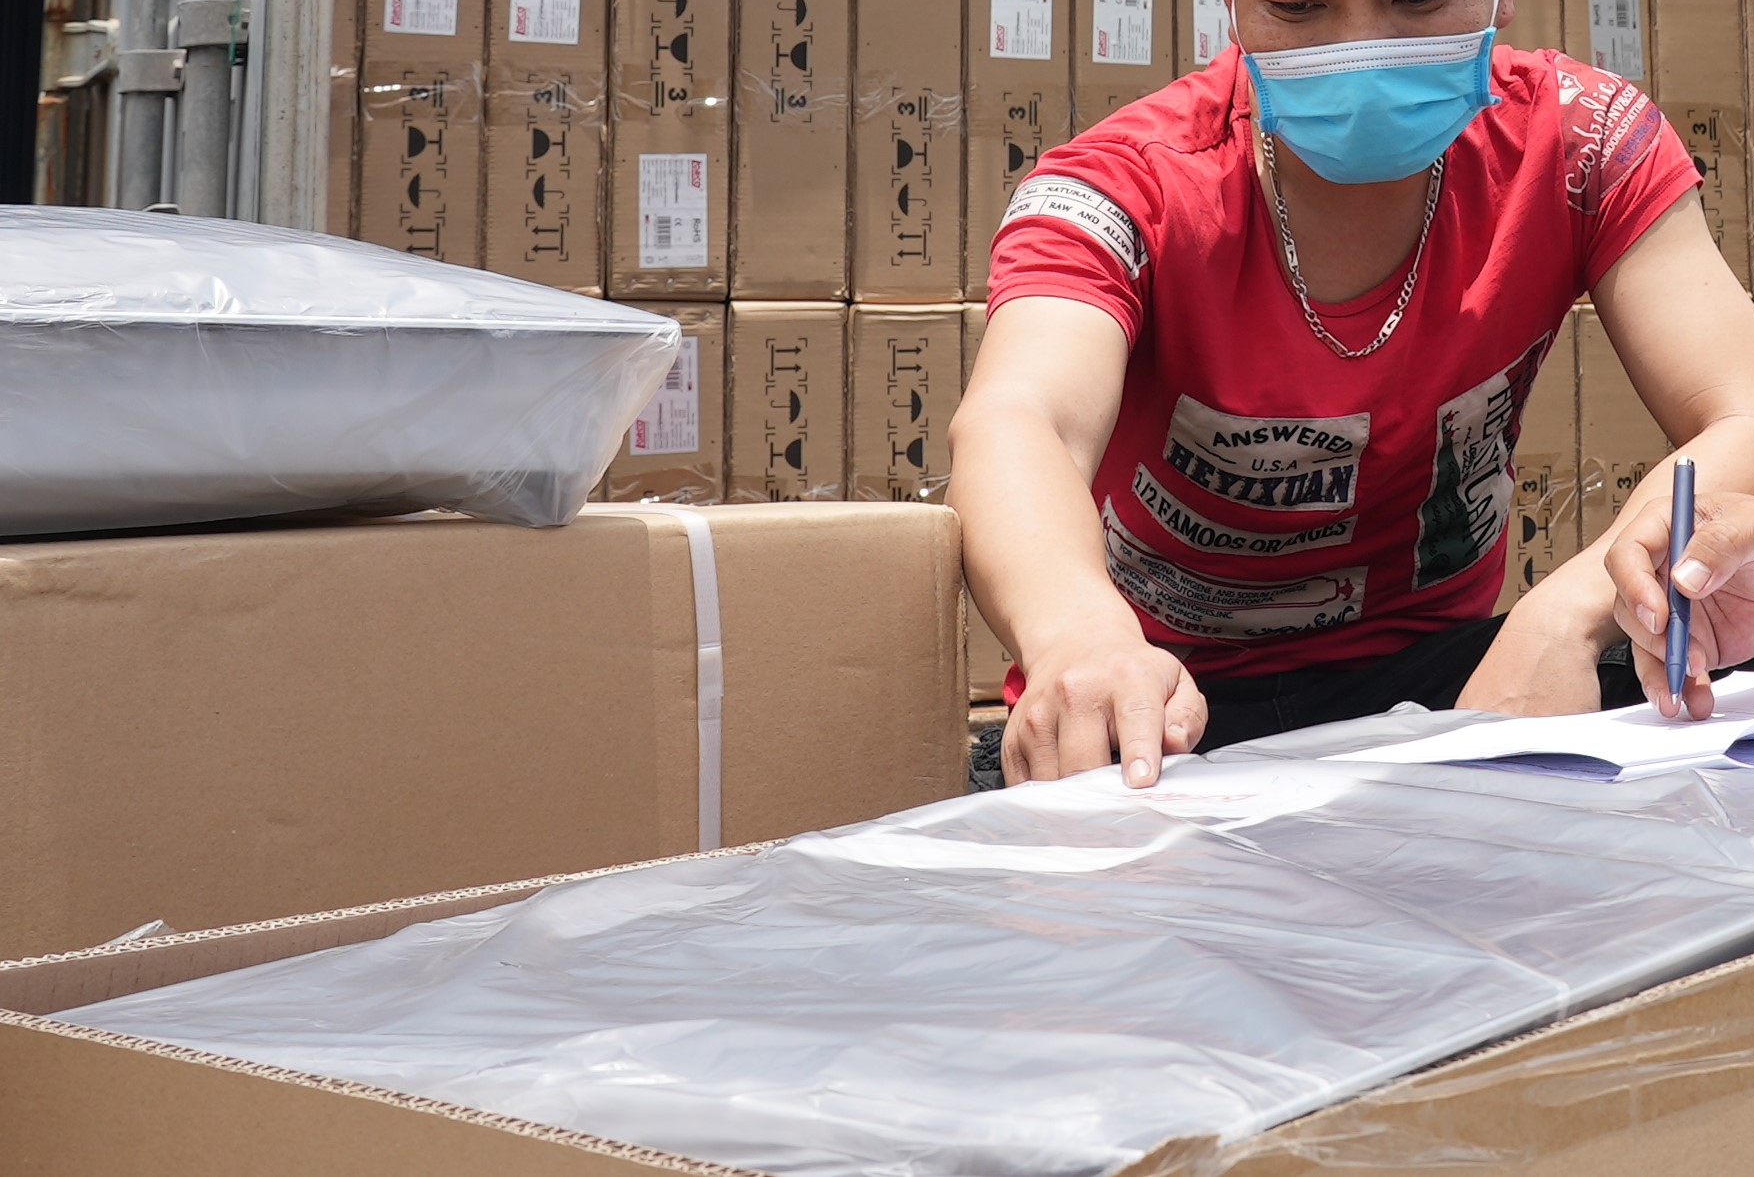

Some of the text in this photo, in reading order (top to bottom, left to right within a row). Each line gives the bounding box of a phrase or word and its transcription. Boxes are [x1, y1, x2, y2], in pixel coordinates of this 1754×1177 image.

[668, 88, 688, 101] 3
[897, 102, 915, 115] 3
[1008, 107, 1026, 120] 3
[1692, 123, 1707, 135] 3
[1046, 186, 1094, 202] NATURAL
[1048, 201, 1073, 213] RAW
[1077, 211, 1100, 225] AND
[1212, 424, 1353, 454] ANSWERED
[1251, 458, 1298, 472] U.S.A
[1165, 442, 1354, 506] HEYIXUAN
[1522, 480, 1538, 492] 3
[1617, 477, 1632, 489] 3
[1115, 563, 1149, 589] NATIONAL
[1119, 543, 1133, 559] FOR
[1216, 589, 1235, 598] AND
[1124, 579, 1153, 600] WEIGHT
[1167, 603, 1203, 622] OUNCES
